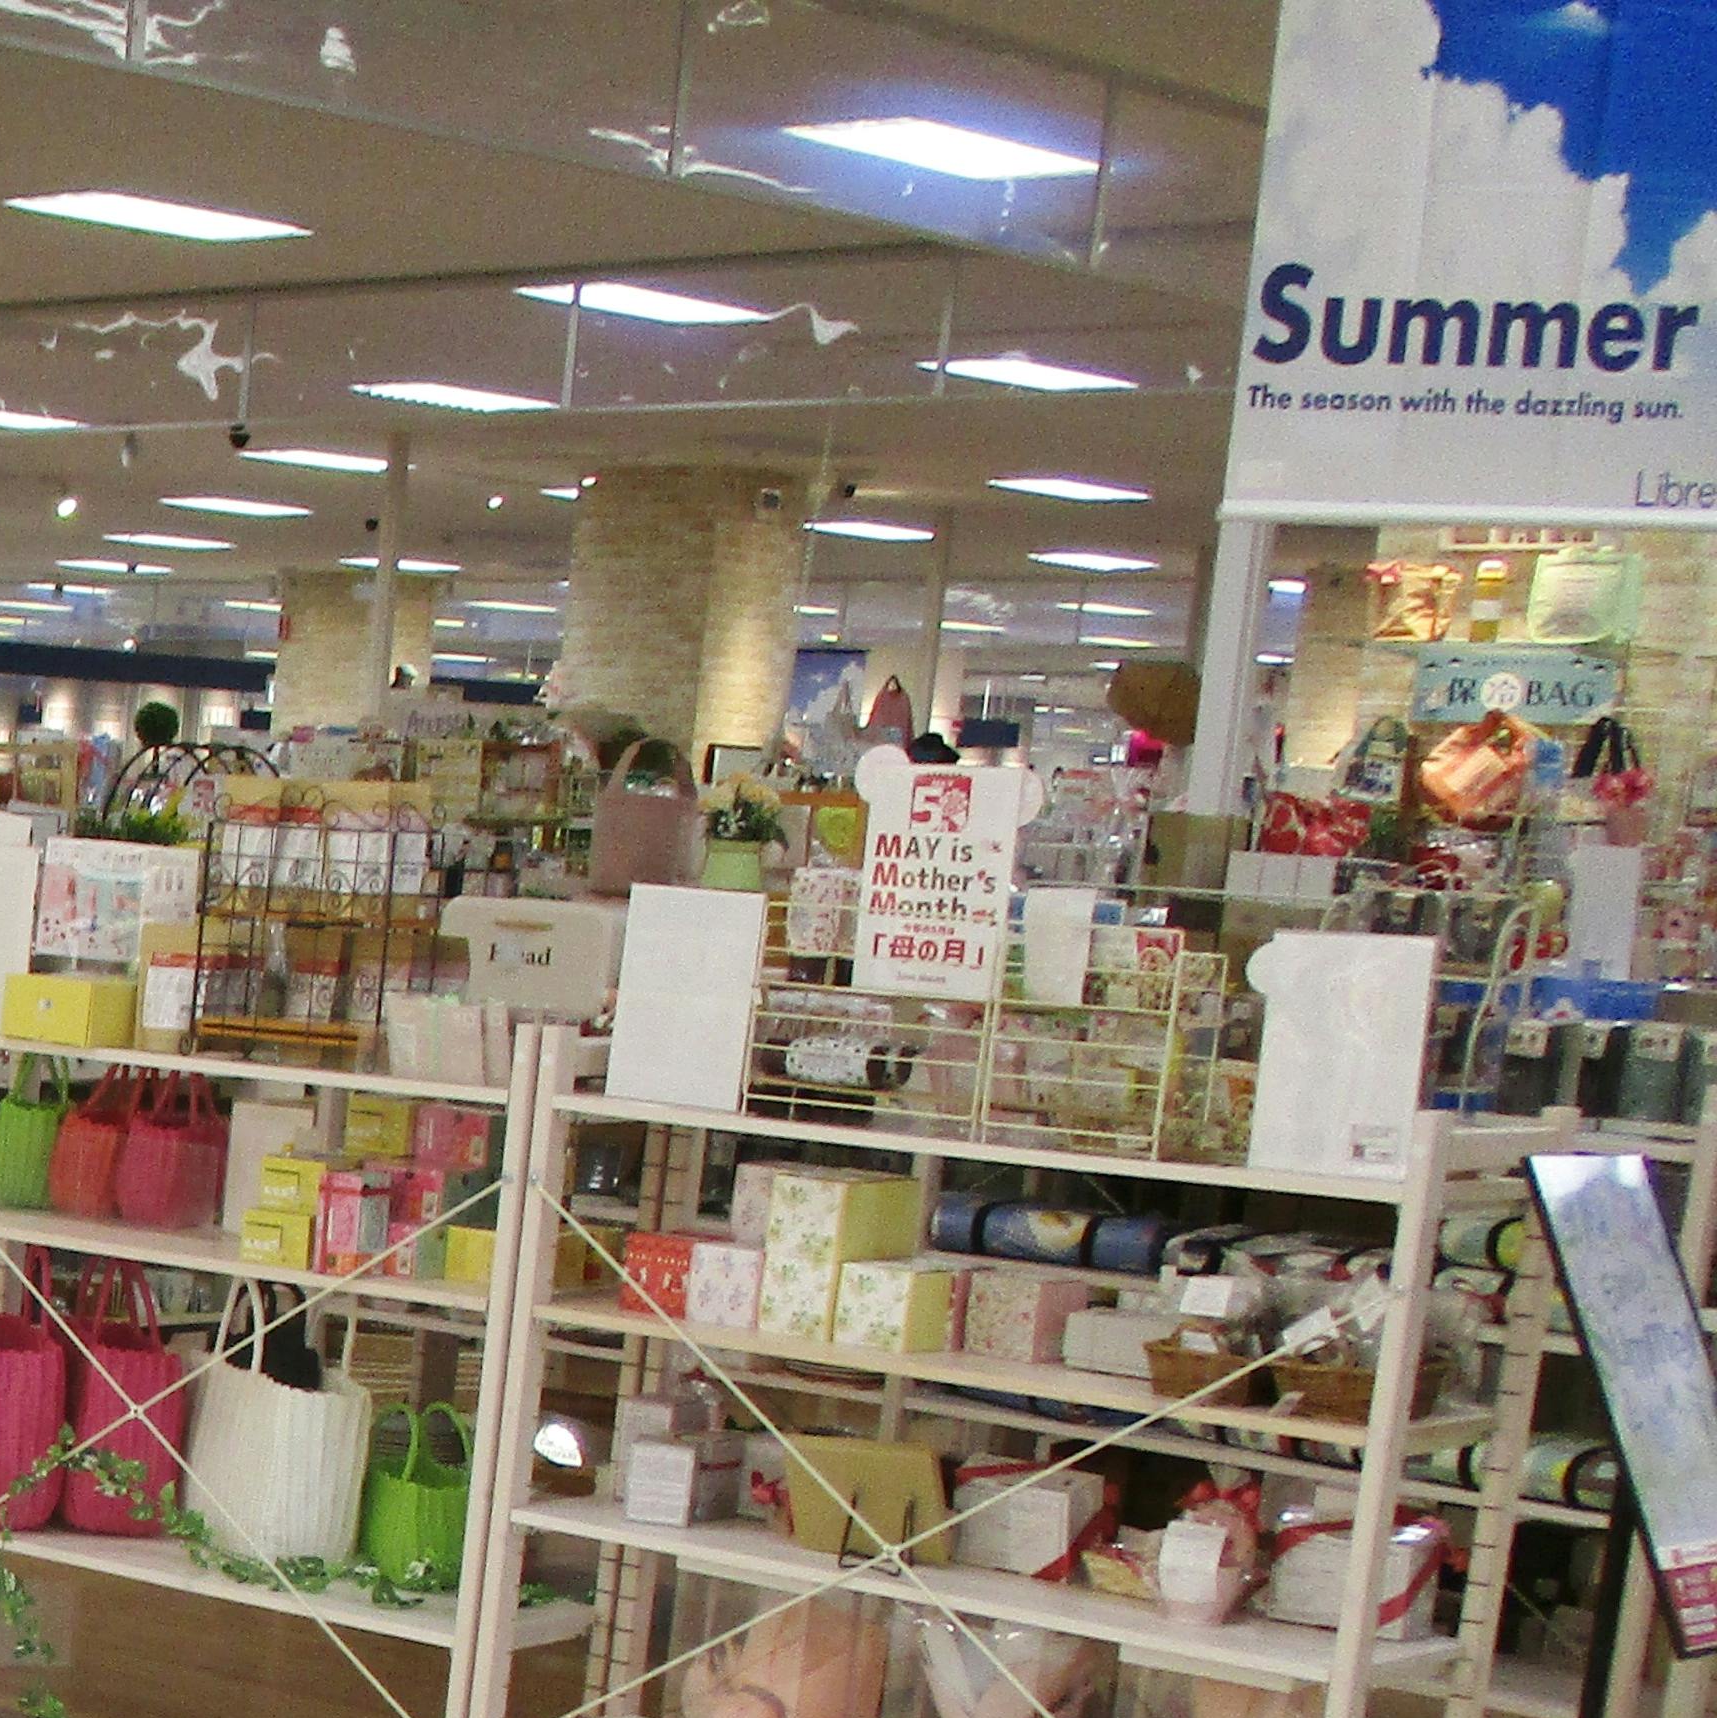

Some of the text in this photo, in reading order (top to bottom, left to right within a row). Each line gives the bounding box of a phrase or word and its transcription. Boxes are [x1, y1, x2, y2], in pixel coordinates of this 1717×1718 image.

[1252, 261, 1699, 373] Summer
[1247, 385, 1684, 424] The season with the dazzling sun.
[1634, 471, 1717, 509] Libre
[874, 832, 973, 863] MAY is
[871, 862, 997, 894] Mother's
[868, 891, 968, 921] Month
